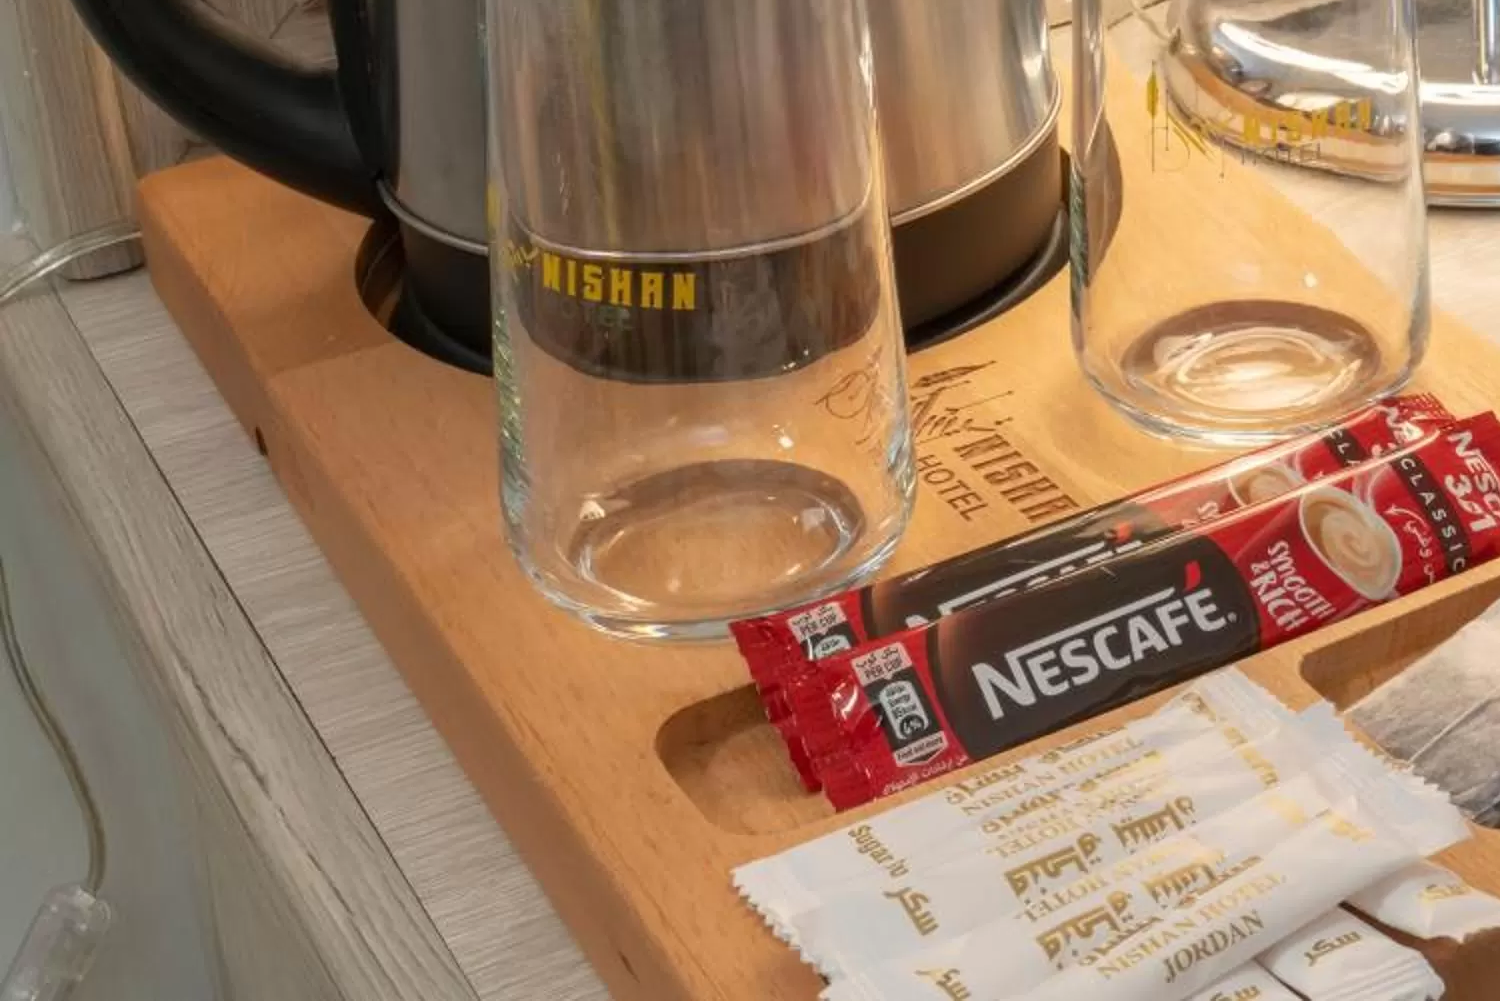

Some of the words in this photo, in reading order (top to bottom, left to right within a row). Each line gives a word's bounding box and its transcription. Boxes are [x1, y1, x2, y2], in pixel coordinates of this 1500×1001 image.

[542, 252, 697, 311] NISHAN
[917, 453, 989, 521] HOTEL
[953, 433, 1080, 523] NISHA
[1400, 456, 1467, 573] CLASSIC
[1267, 540, 1337, 620] SMOOTH
[848, 824, 894, 866] Sugar
[881, 885, 939, 936] سكر
[1097, 917, 1196, 980] NISHAN
[1163, 909, 1265, 984] JORDAN
[1303, 929, 1363, 968] سكر
